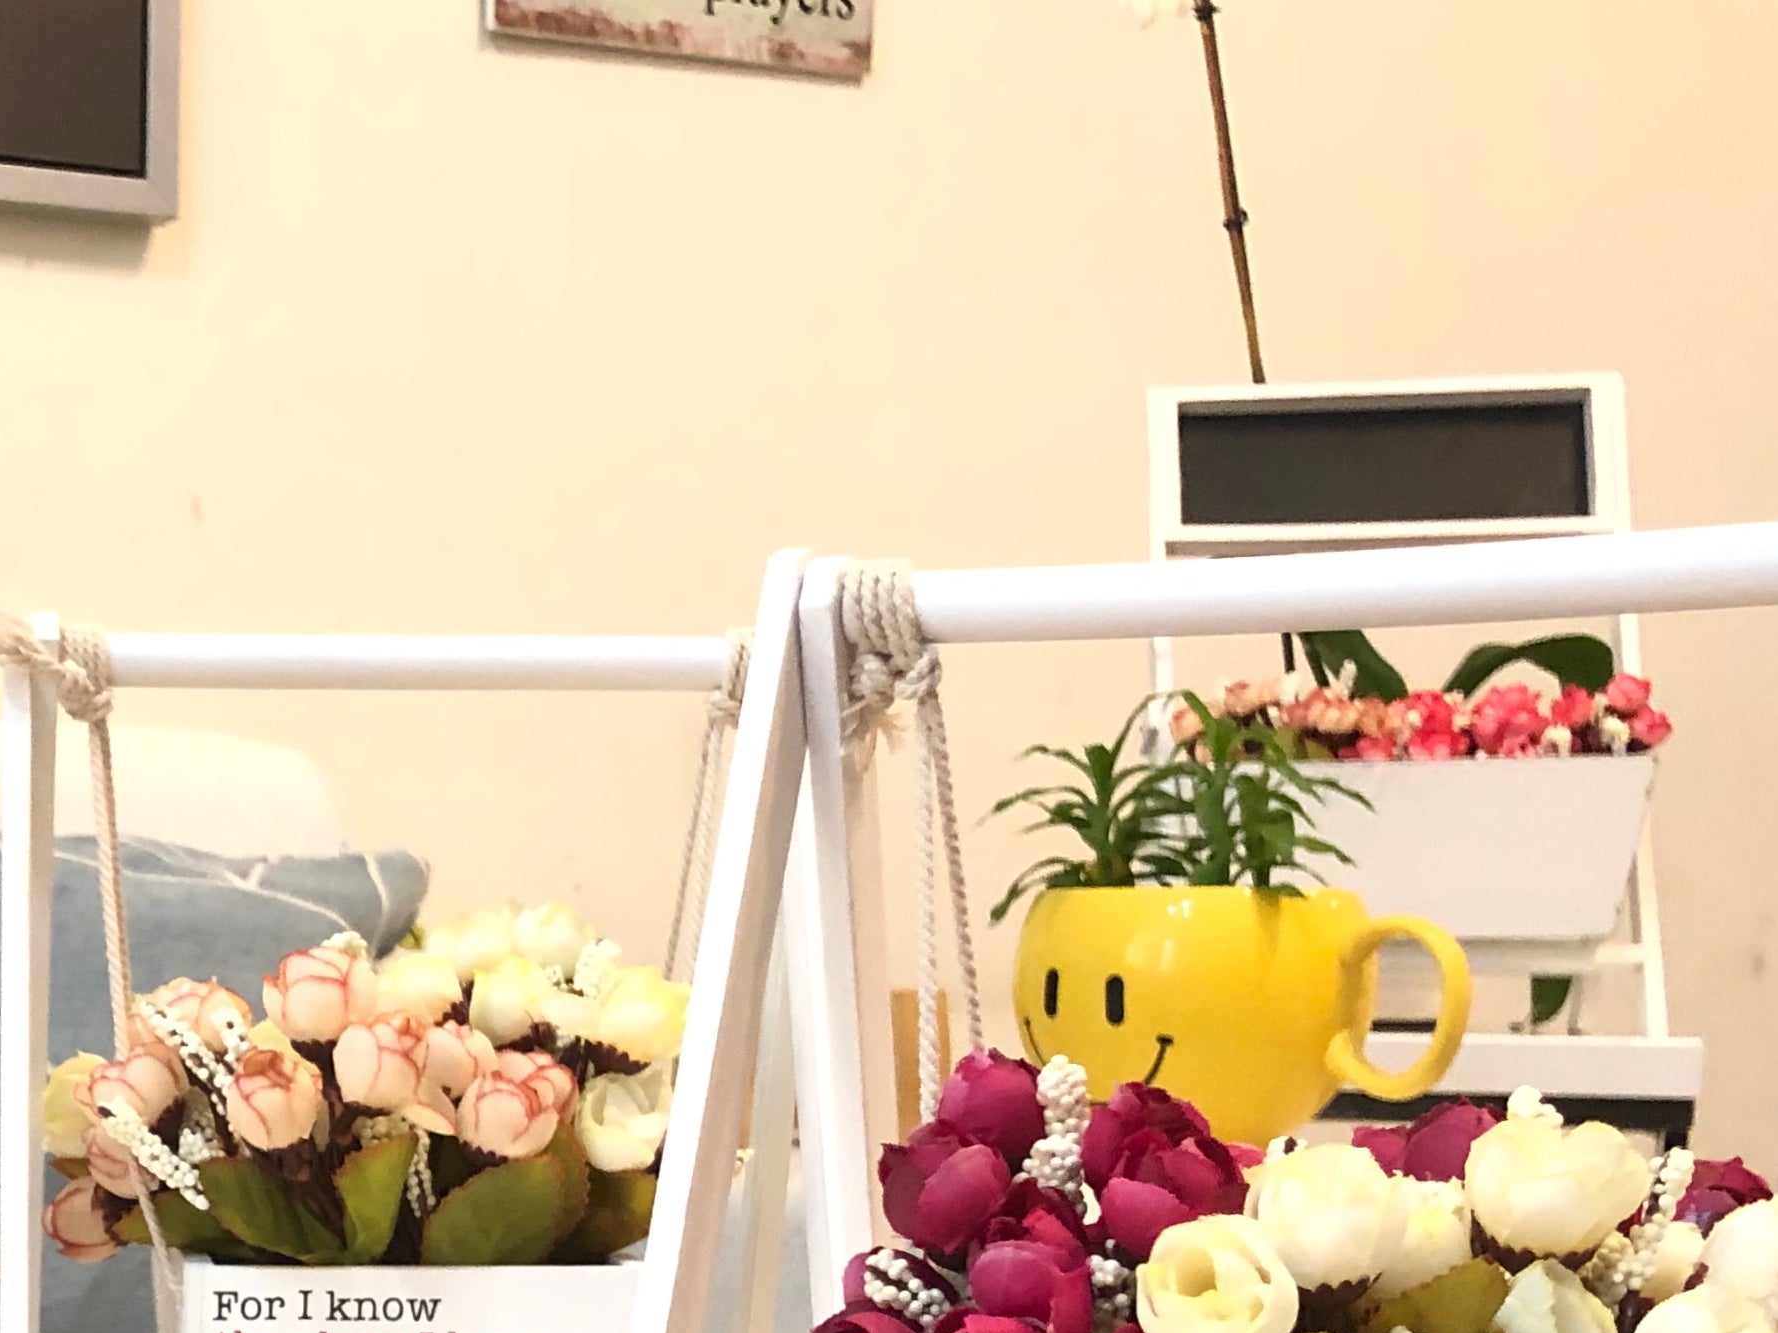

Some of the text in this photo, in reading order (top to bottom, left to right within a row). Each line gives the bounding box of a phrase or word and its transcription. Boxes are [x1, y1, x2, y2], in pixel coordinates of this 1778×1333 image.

[213, 1290, 442, 1322] For I know
